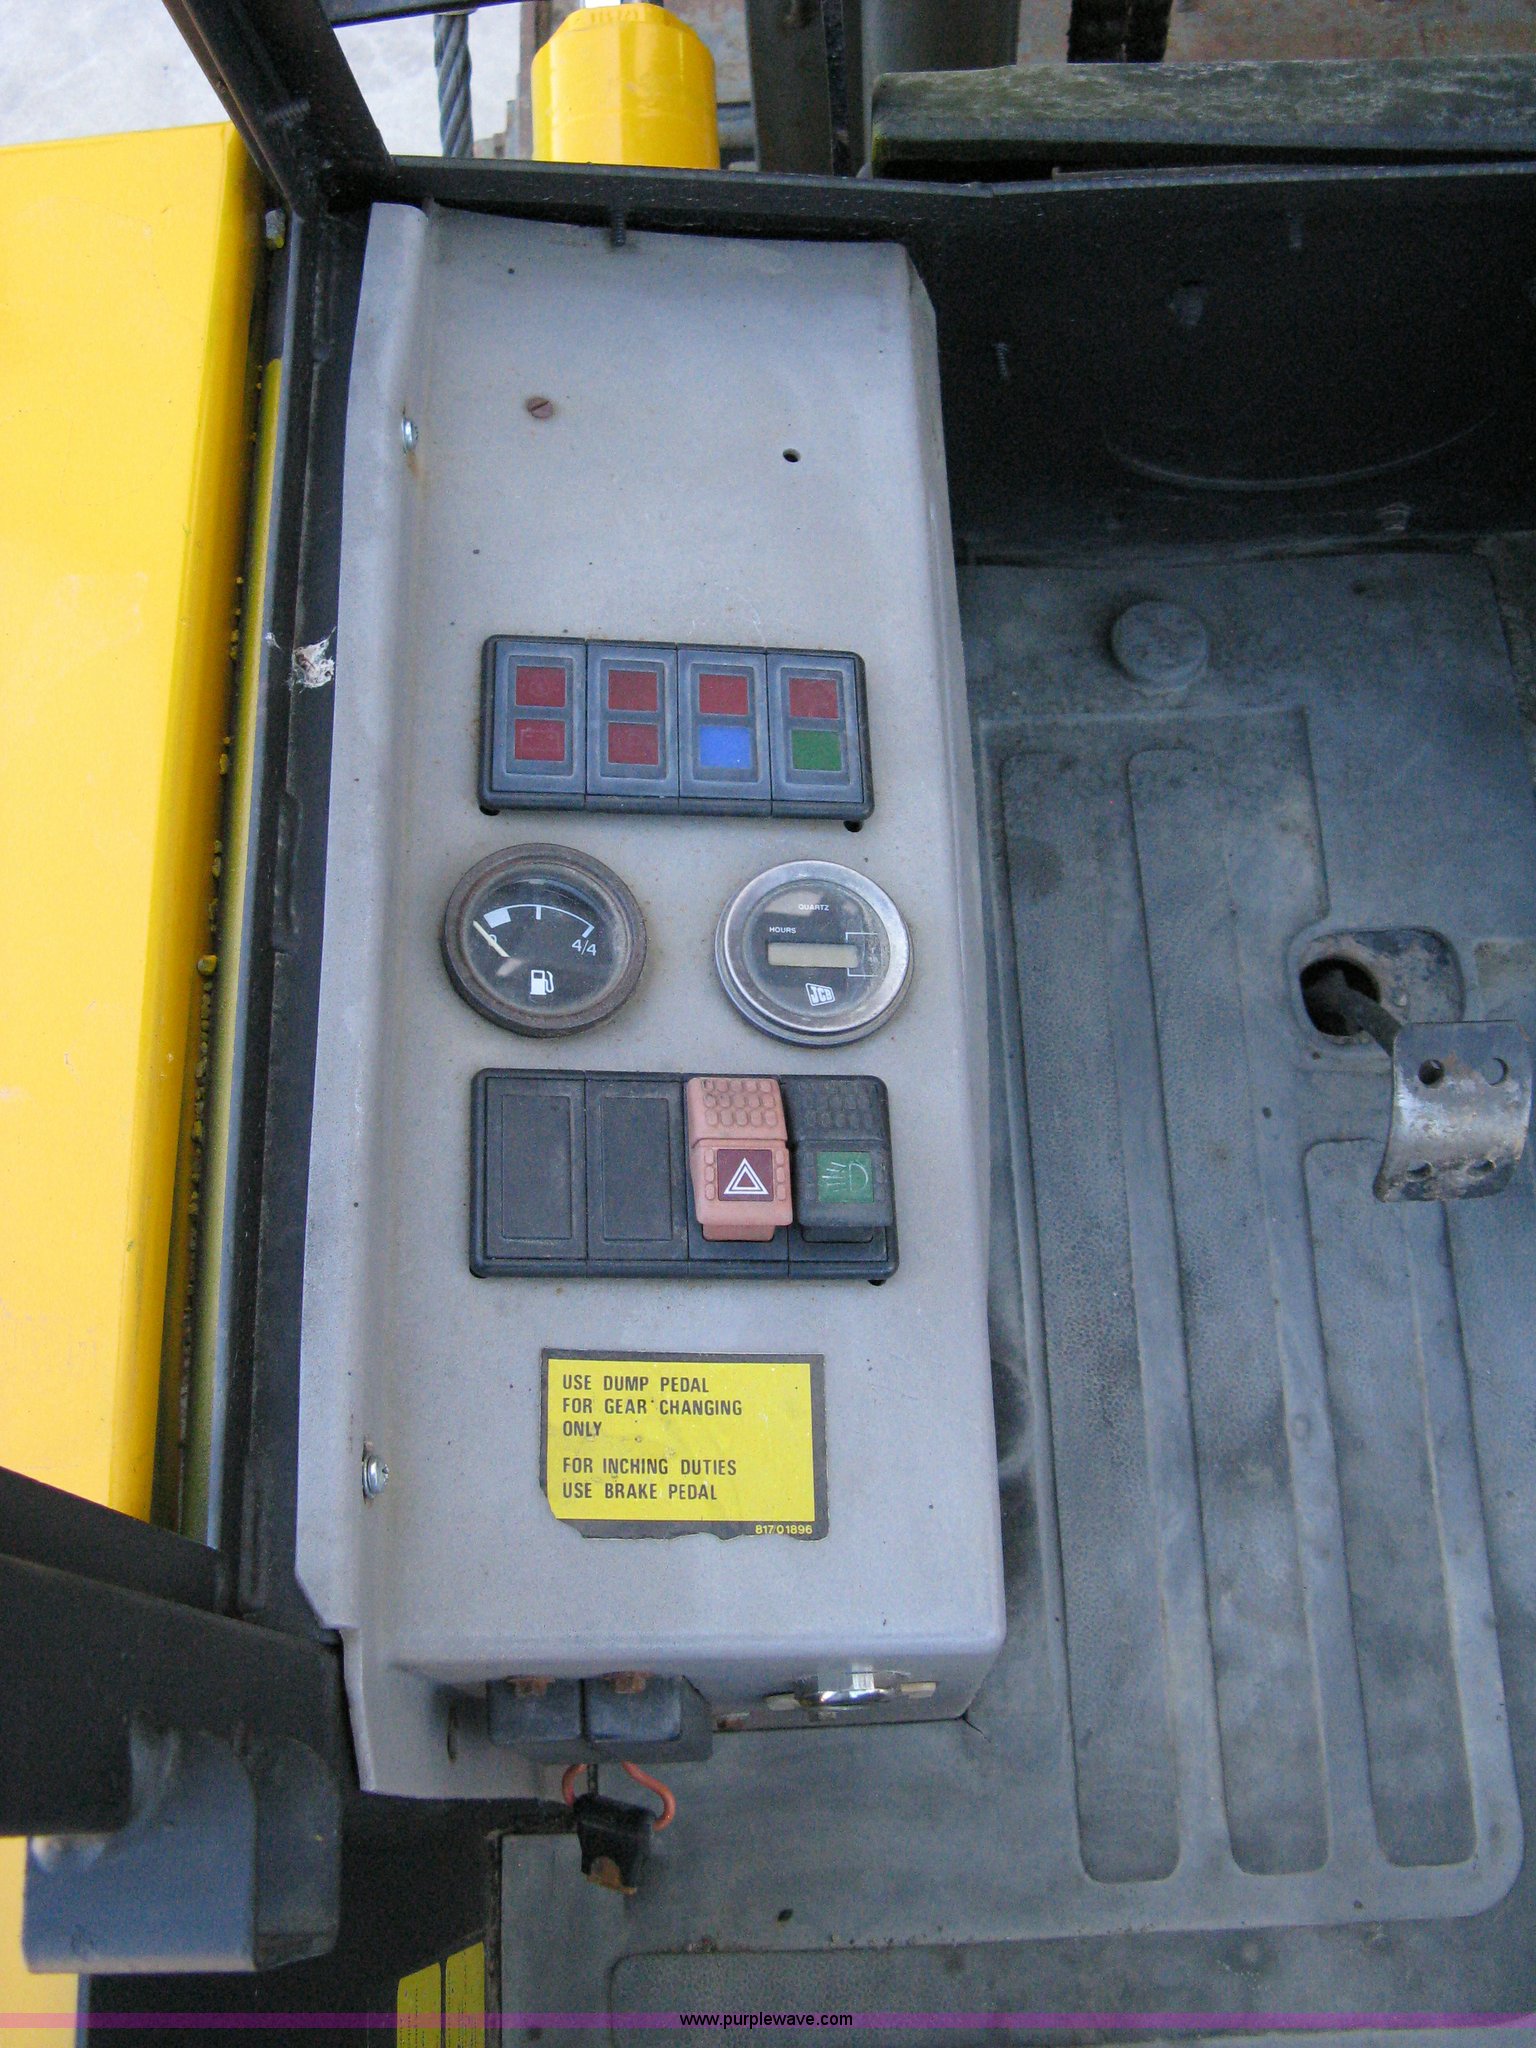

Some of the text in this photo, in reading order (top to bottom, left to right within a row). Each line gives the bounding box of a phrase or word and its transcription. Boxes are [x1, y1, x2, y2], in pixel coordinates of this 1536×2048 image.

[798, 903, 829, 911] QUARTZ
[769, 926, 797, 934] HOURS
[571, 939, 597, 956] 4/4
[810, 986, 832, 1003] JCB
[562, 1374, 709, 1393] USE DUMP PEDAL
[562, 1398, 742, 1416] FOR GEAR CHANGING
[562, 1421, 602, 1437] ONLY
[562, 1458, 737, 1475] FOR INCHING DUTIES
[562, 1482, 717, 1500] USE BRAKE PEDAL
